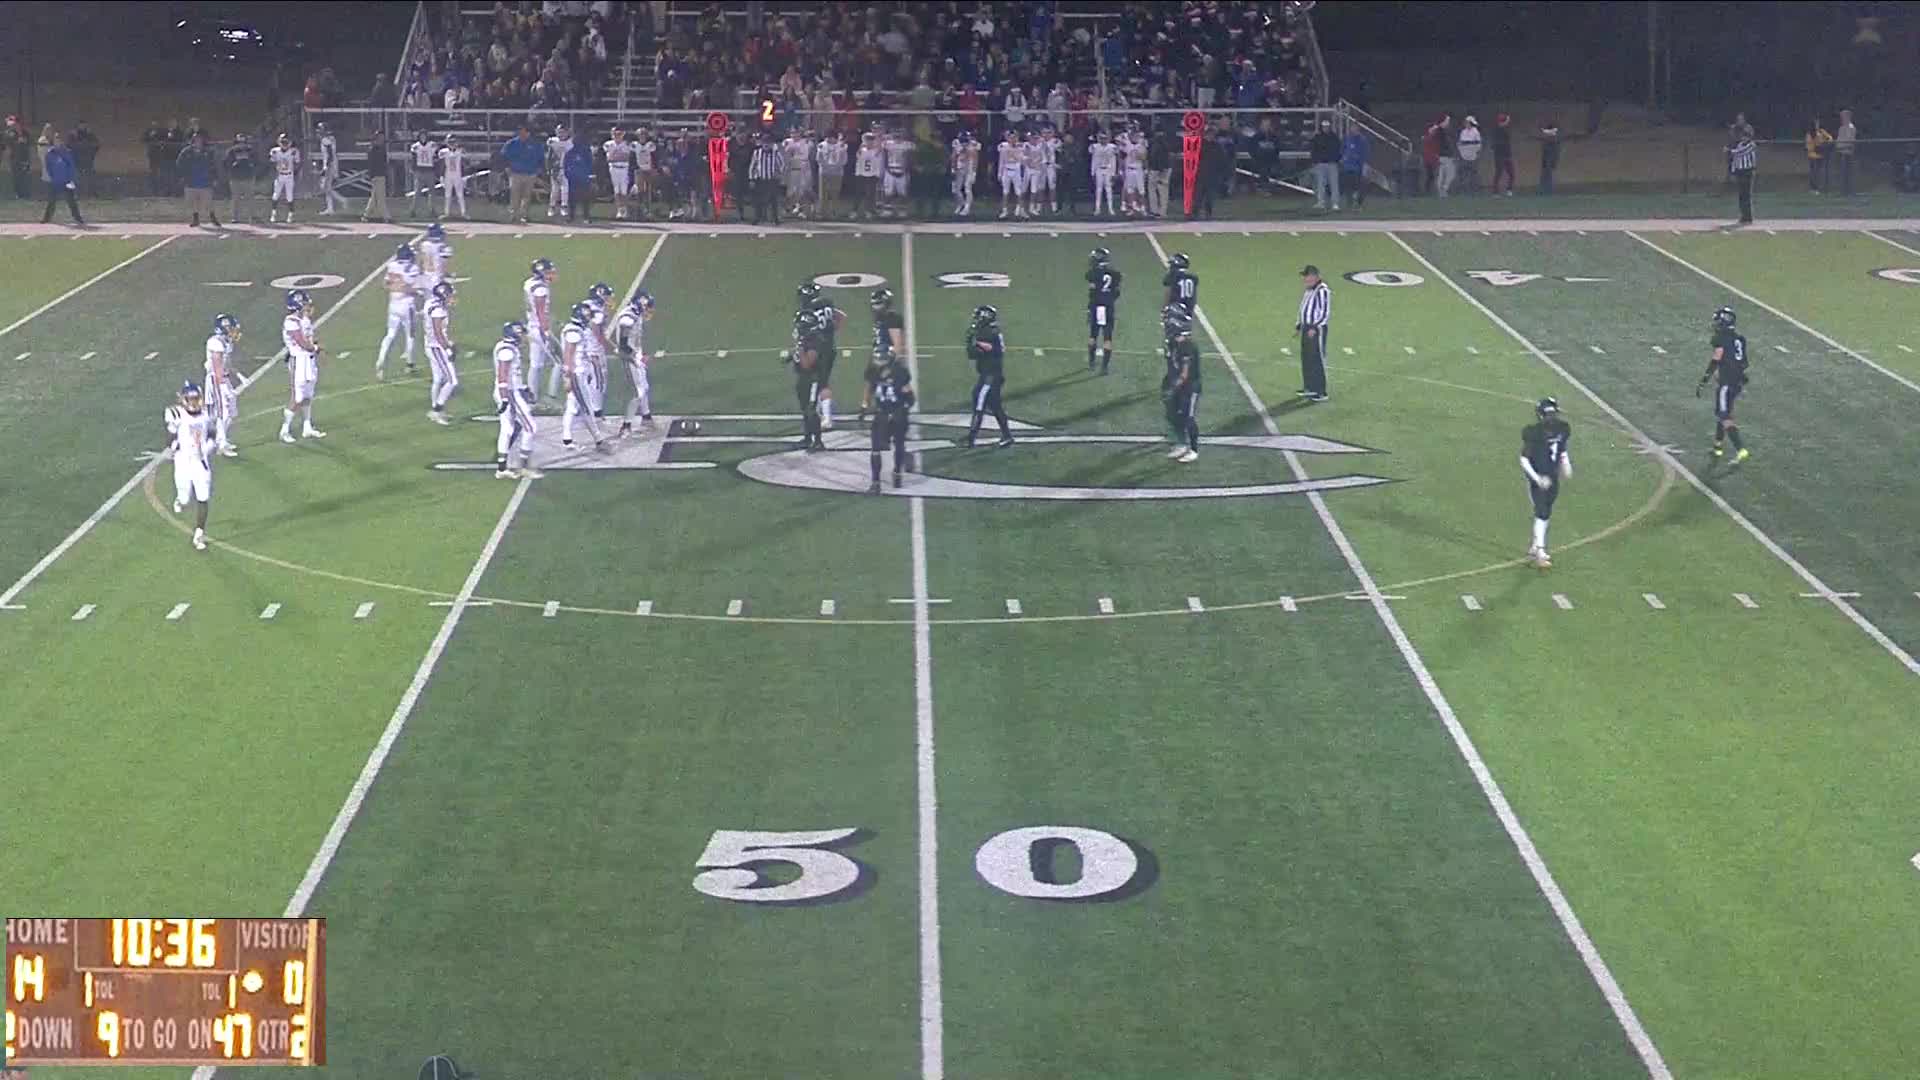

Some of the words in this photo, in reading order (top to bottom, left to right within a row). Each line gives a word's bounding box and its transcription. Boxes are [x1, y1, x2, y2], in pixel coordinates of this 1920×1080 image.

[761, 100, 774, 121] 2
[1102, 274, 1112, 292] 2
[1178, 278, 1194, 299] 10
[1734, 339, 1743, 361] 3
